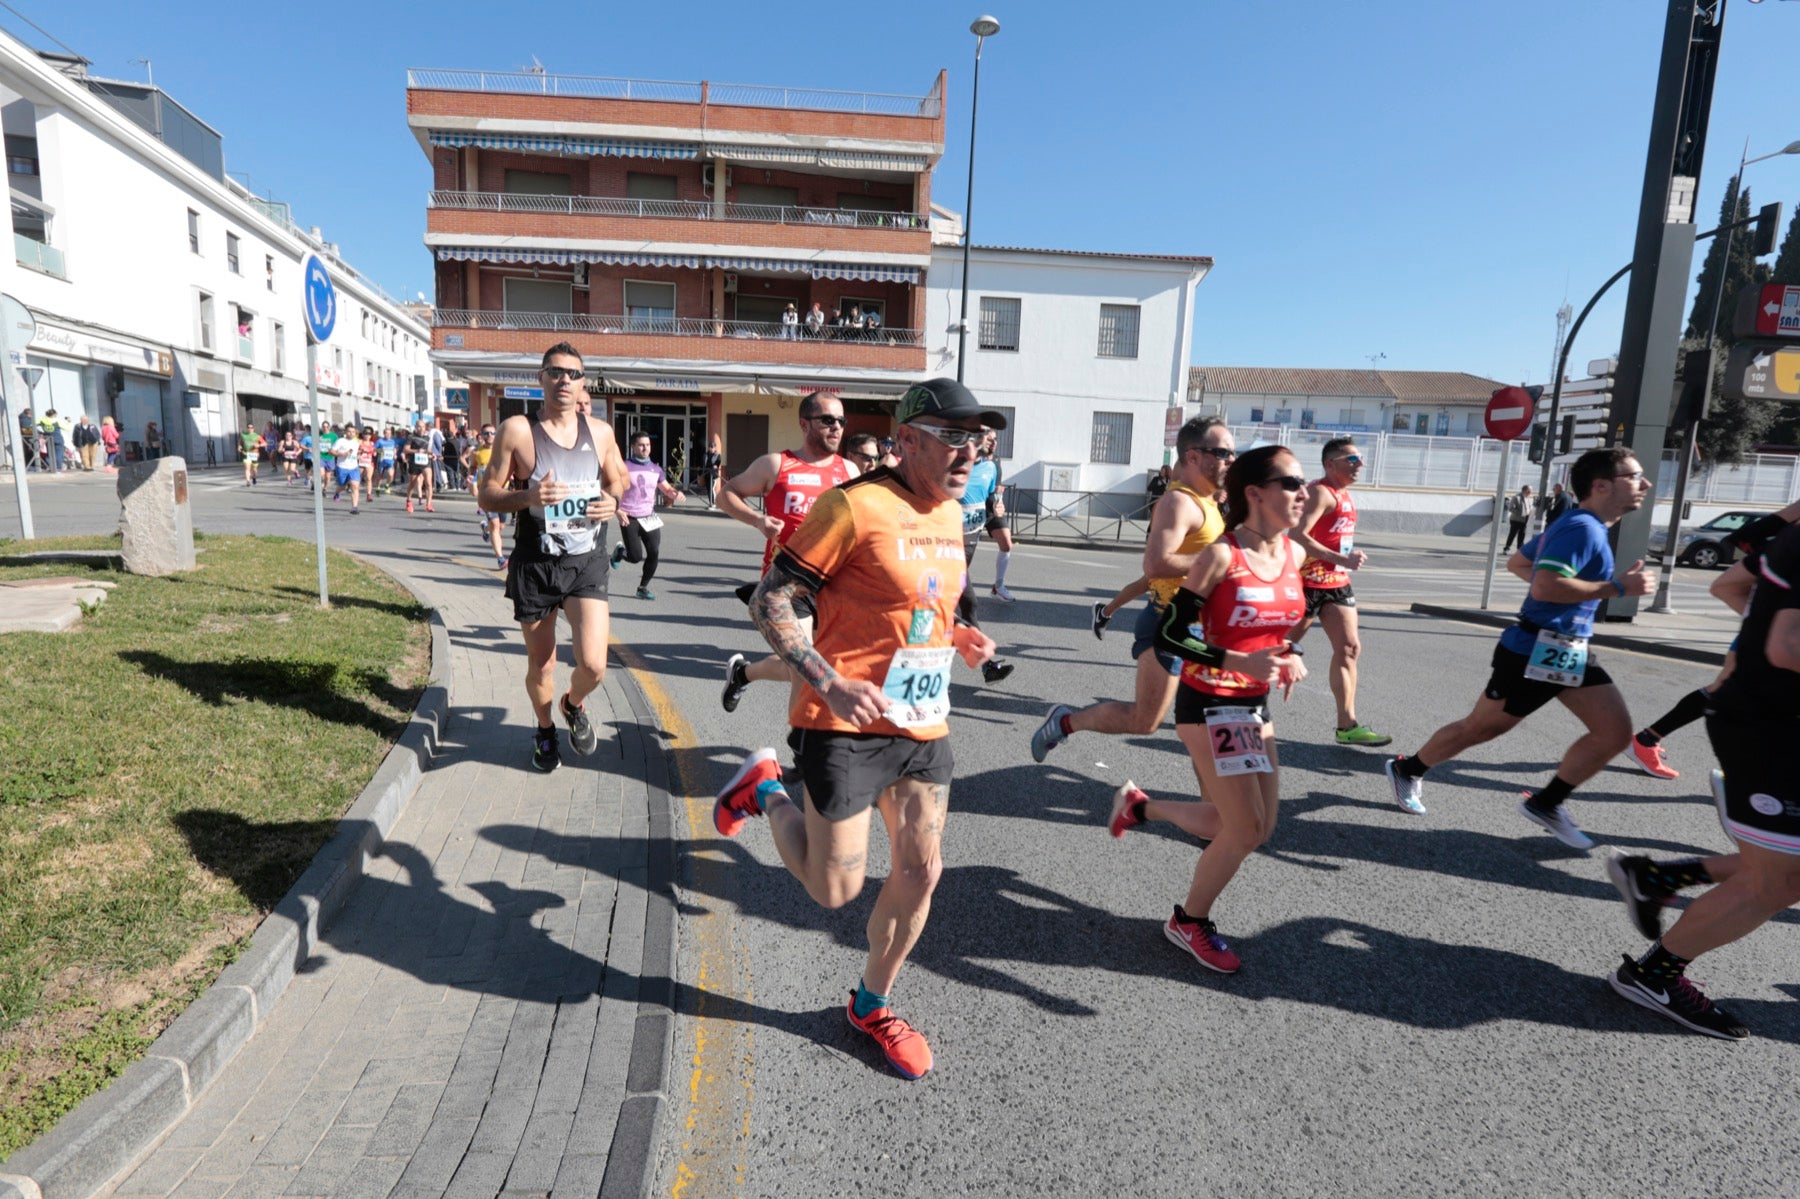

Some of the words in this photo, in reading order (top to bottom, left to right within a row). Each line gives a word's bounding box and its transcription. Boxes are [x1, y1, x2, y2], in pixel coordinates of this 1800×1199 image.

[36, 326, 76, 351] Beauty
[494, 371, 538, 382] RESTAU
[1750, 373, 1766, 382] 100
[655, 378, 700, 389] PARADA
[1747, 385, 1765, 393] mts
[909, 536, 933, 546] Club
[1540, 647, 1579, 670] 295
[902, 671, 943, 700] 190
[1214, 726, 1264, 754] 2136
